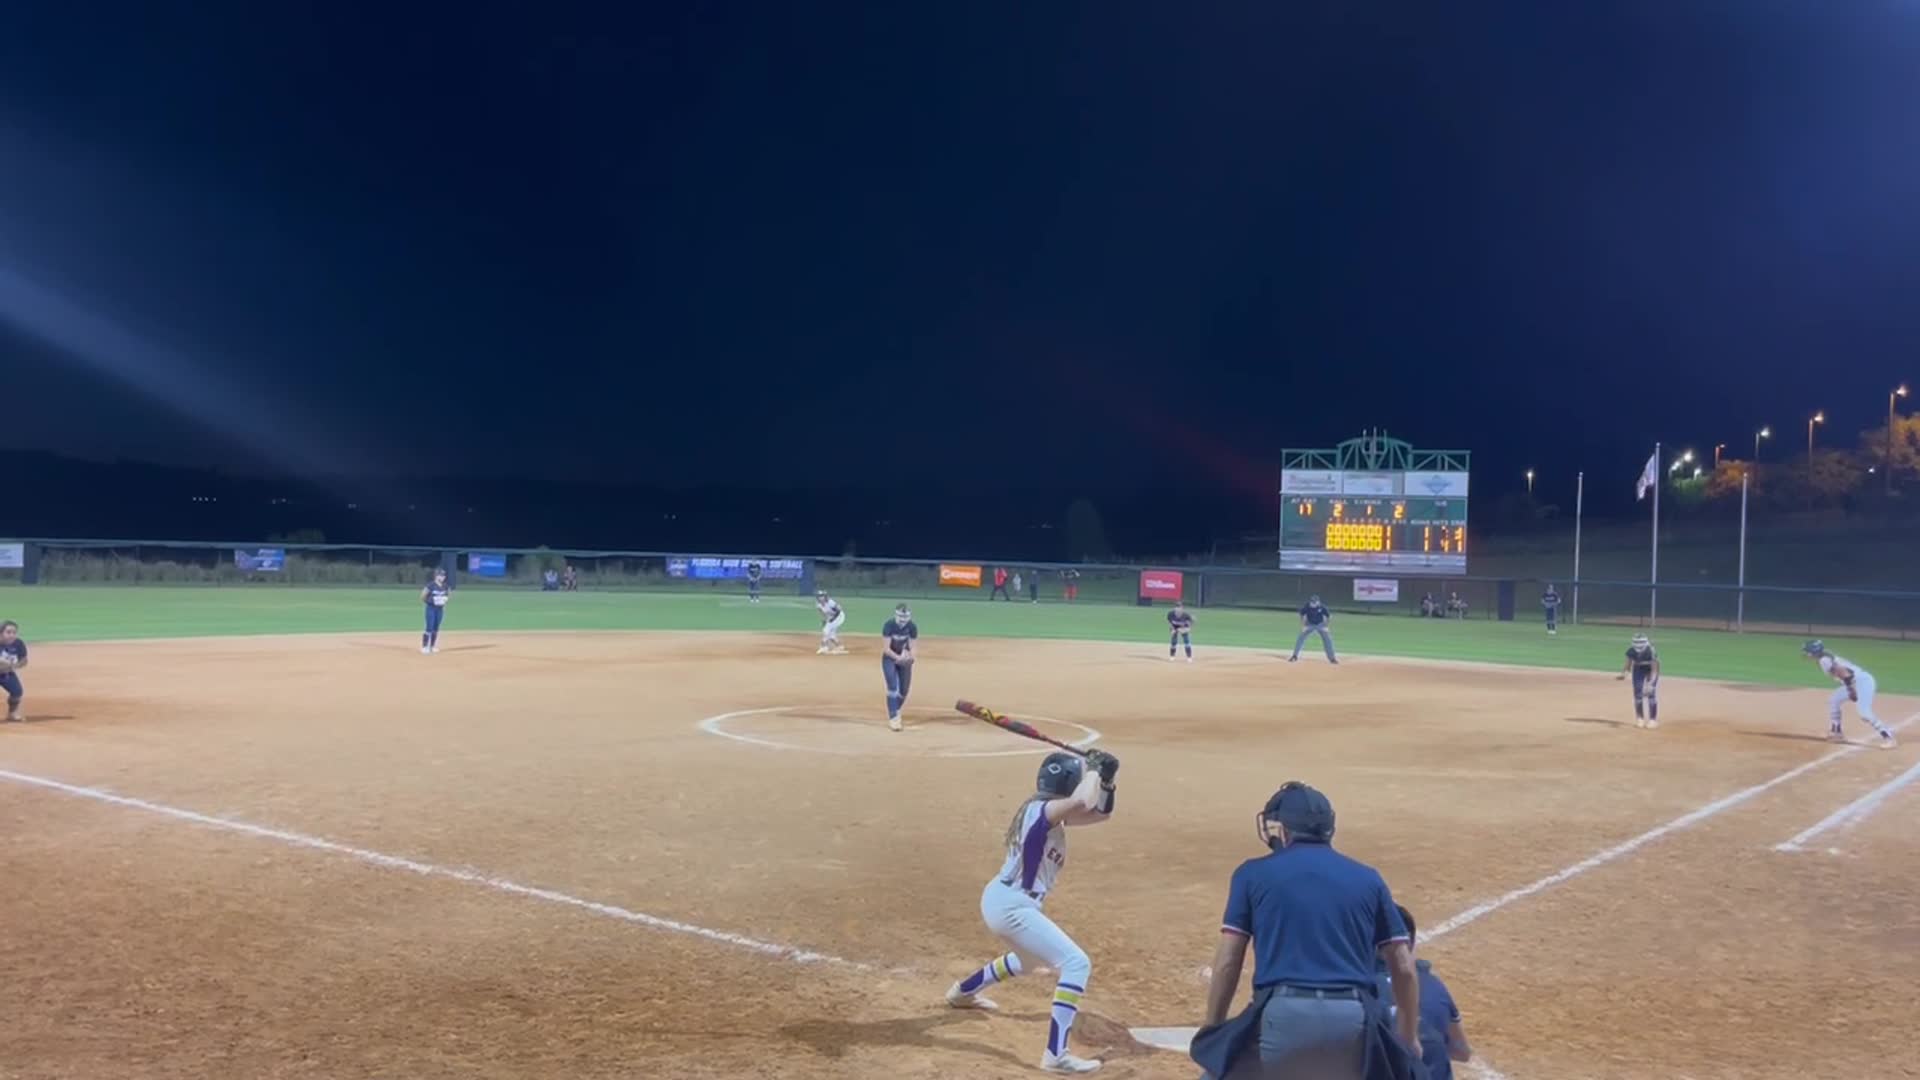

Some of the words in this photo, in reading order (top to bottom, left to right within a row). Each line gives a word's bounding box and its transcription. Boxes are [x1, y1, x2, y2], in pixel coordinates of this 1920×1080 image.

[1333, 503, 1343, 518] 2
[1394, 504, 1404, 519] 2
[691, 558, 721, 567] FLORIDA
[769, 559, 803, 569] SOFTBALL
